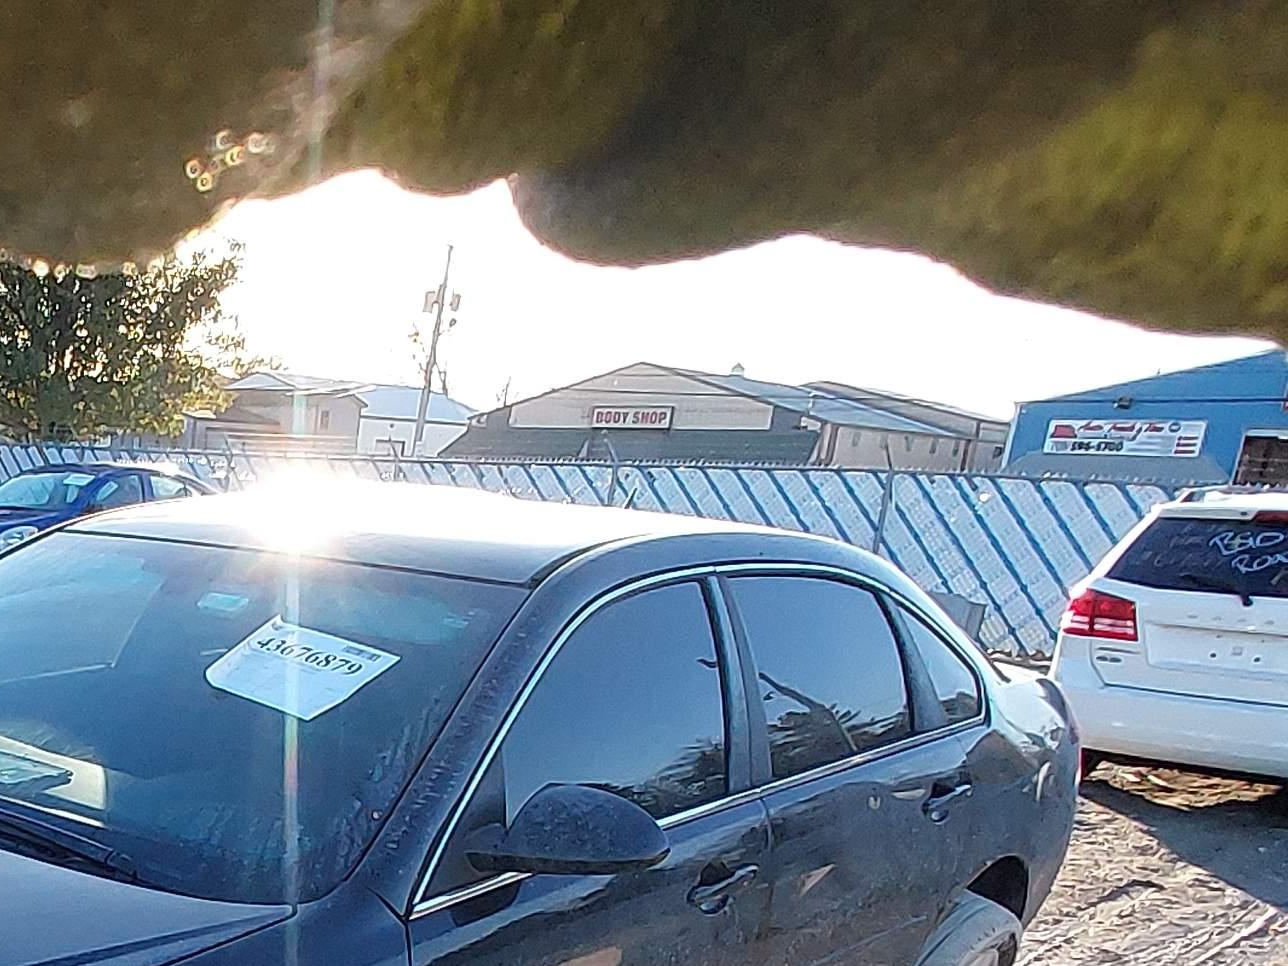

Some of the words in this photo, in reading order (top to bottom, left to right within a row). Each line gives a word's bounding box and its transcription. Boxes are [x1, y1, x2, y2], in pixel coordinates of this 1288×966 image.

[596, 411, 629, 424] BODY
[632, 411, 667, 424] SHOP
[256, 637, 363, 676] 43676879
